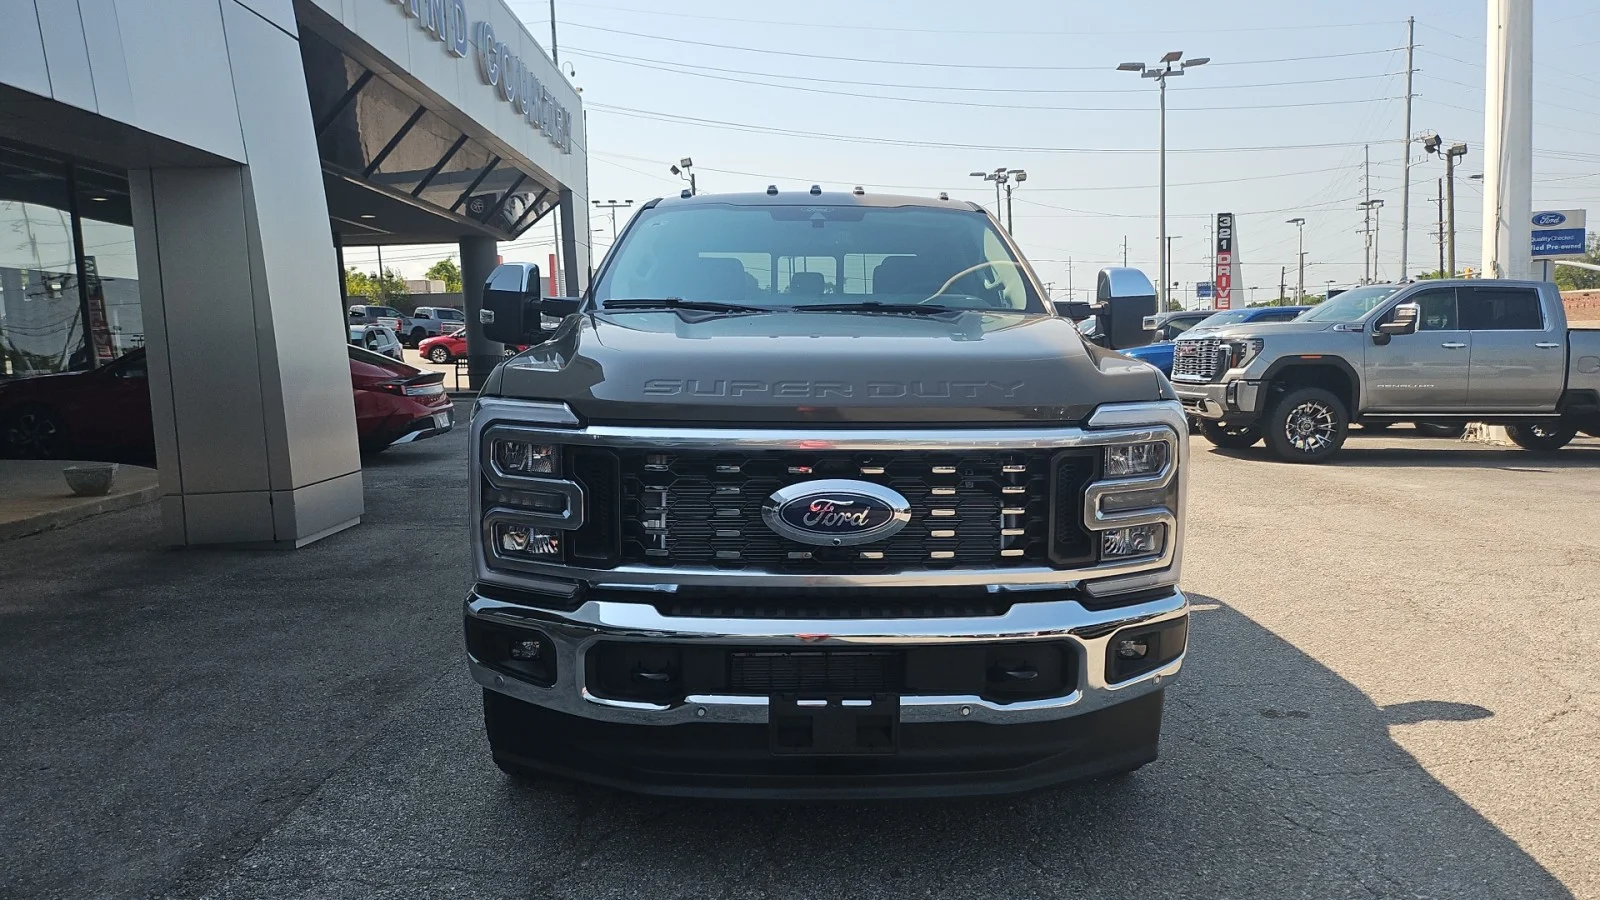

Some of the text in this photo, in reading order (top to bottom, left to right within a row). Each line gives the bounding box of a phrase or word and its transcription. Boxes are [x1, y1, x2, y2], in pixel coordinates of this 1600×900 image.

[394, 0, 572, 154] ND COUNTRY
[1540, 214, 1560, 224] Ford
[1546, 243, 1582, 251] Pre-owned
[1217, 216, 1231, 308] 321 DRIVE
[643, 379, 1025, 398] SUPER DUTY
[802, 498, 871, 527] Ford
